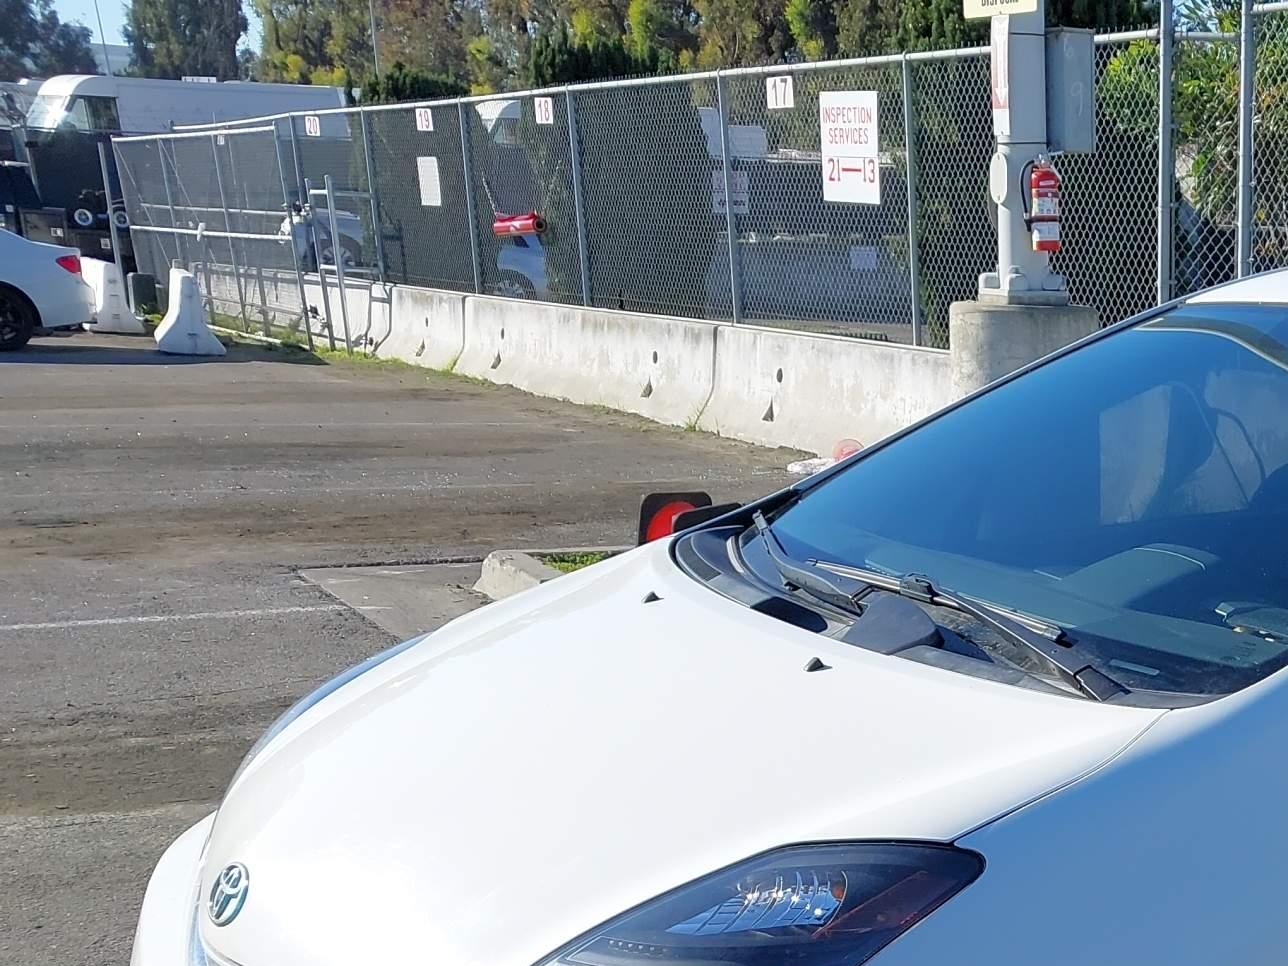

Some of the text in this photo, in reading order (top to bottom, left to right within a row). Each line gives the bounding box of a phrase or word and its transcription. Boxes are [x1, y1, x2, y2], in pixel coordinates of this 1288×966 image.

[771, 77, 789, 107] 17
[418, 109, 431, 129] 19
[537, 99, 551, 122] 18
[822, 106, 872, 124] INSPECTION
[307, 117, 318, 135] 20
[828, 127, 869, 145] SERVICES
